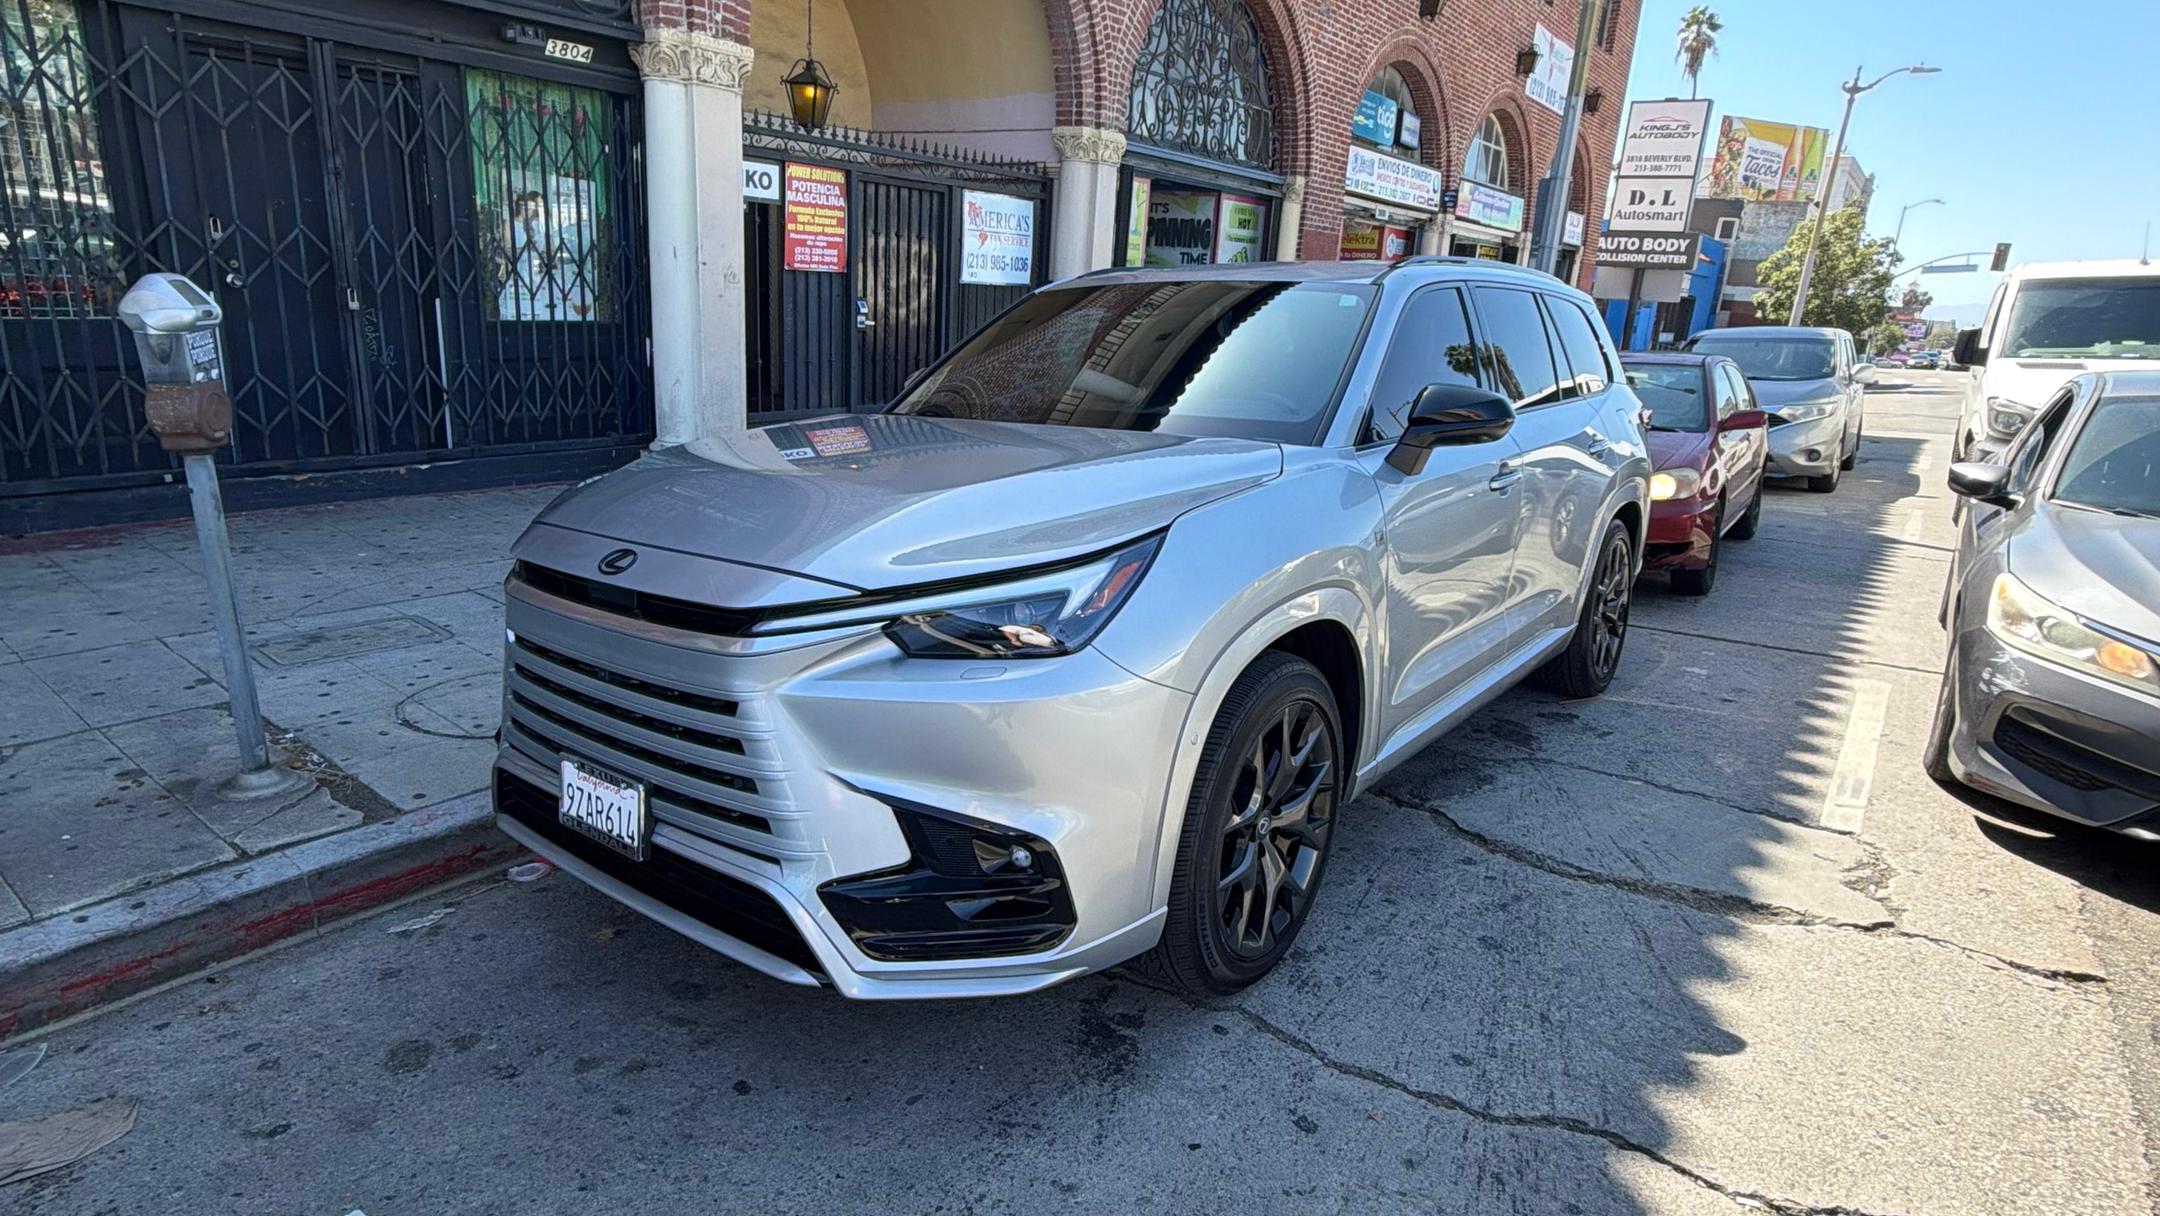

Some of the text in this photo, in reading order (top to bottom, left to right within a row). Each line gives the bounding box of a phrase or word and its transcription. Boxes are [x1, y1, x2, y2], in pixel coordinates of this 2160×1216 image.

[547, 40, 592, 61] 3804
[1377, 105, 1396, 129] tigo
[1629, 132, 1700, 140] AUTOBODY
[1643, 154, 1673, 163] BEVERLY
[1744, 154, 1780, 178] Tacos
[788, 165, 811, 180] POWER
[1377, 158, 1400, 175] ENVIOS
[1401, 164, 1410, 177] DE
[745, 169, 773, 191] KO
[792, 180, 841, 196] POTENCIA
[787, 191, 846, 207] MASCULINA
[1150, 202, 1169, 214] IT'S
[1614, 209, 1684, 221] Autosmart
[968, 204, 1030, 233] AMERICA'S
[1598, 236, 1691, 252] AUTO BODY
[966, 252, 1029, 273] (213) 985-1036
[1179, 251, 1208, 265] TIME
[1647, 254, 1688, 264] CENTER
[576, 770, 621, 795] California
[566, 782, 636, 845] 9ZAR614
